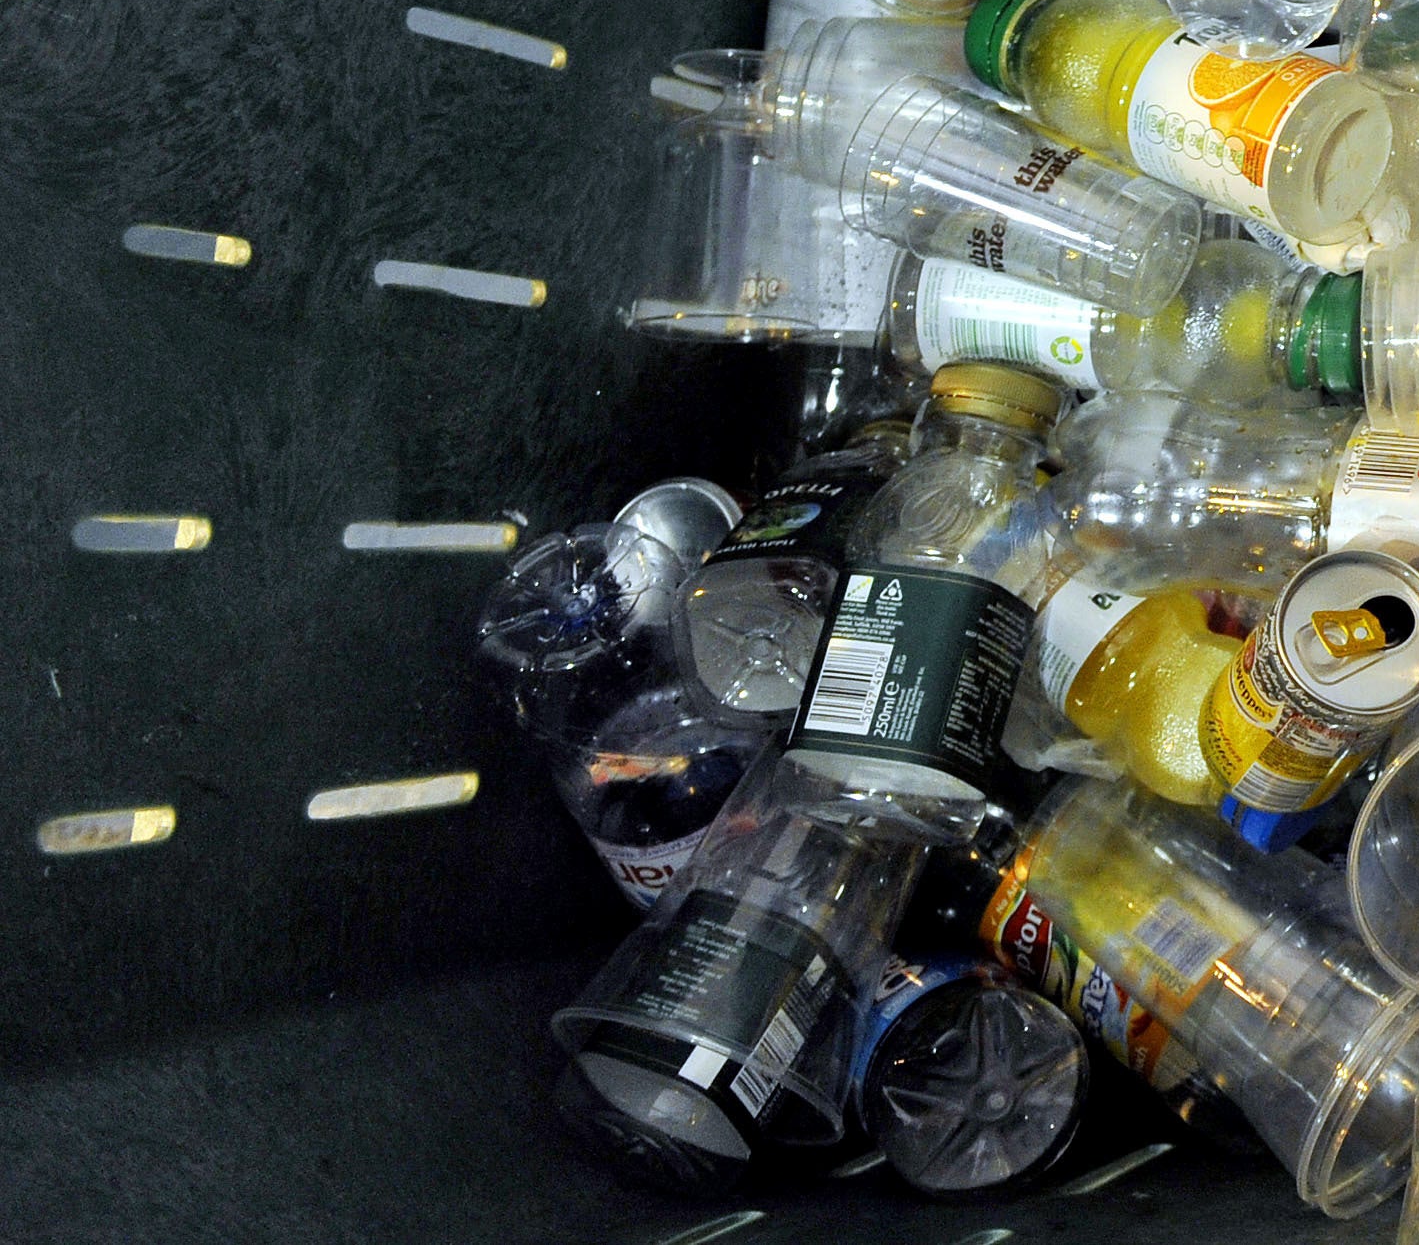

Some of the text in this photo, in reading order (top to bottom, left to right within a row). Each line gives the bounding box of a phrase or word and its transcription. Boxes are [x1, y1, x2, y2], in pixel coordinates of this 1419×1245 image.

[1013, 145, 1057, 188] this
[1032, 144, 1087, 194] water
[763, 480, 846, 503] OPELLA
[1015, 904, 1044, 976] pton
